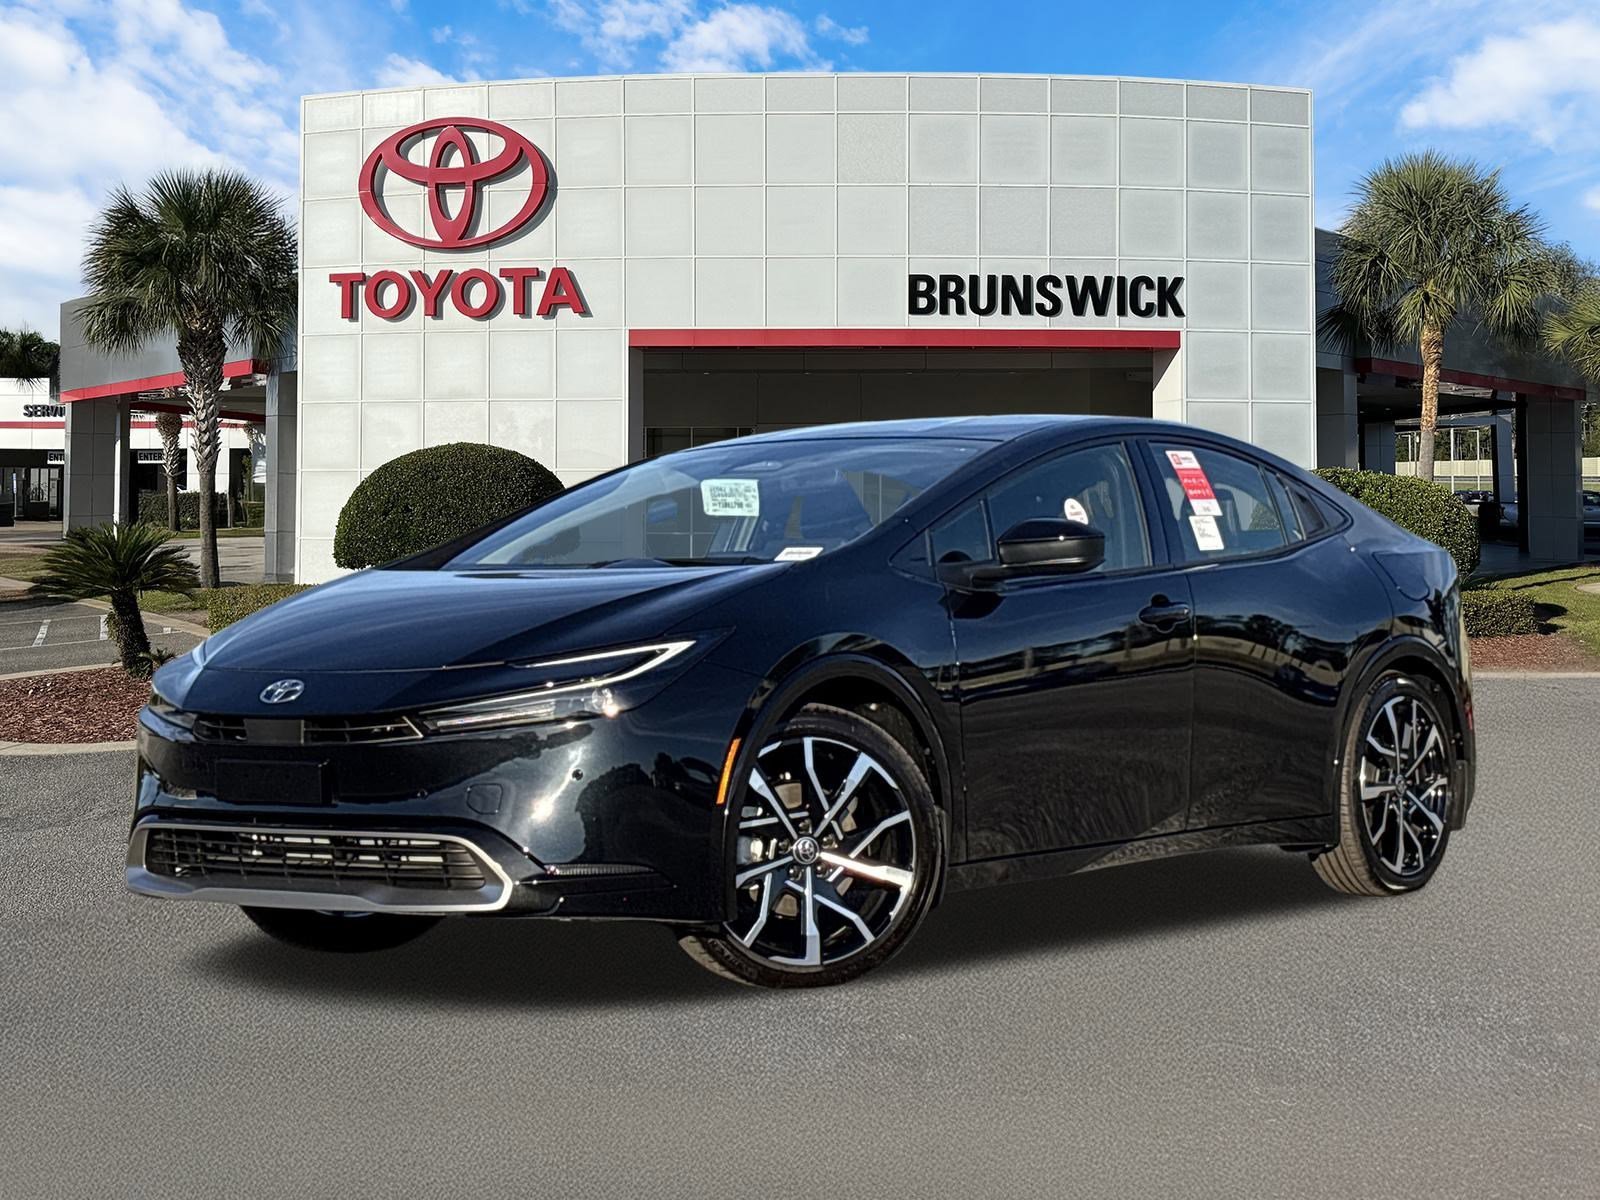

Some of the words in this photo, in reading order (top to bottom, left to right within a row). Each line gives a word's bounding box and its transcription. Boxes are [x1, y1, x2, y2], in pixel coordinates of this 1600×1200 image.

[329, 266, 587, 320] TOYOTA
[908, 274, 1186, 317] BRUNSWICK
[23, 404, 66, 418] SERVI
